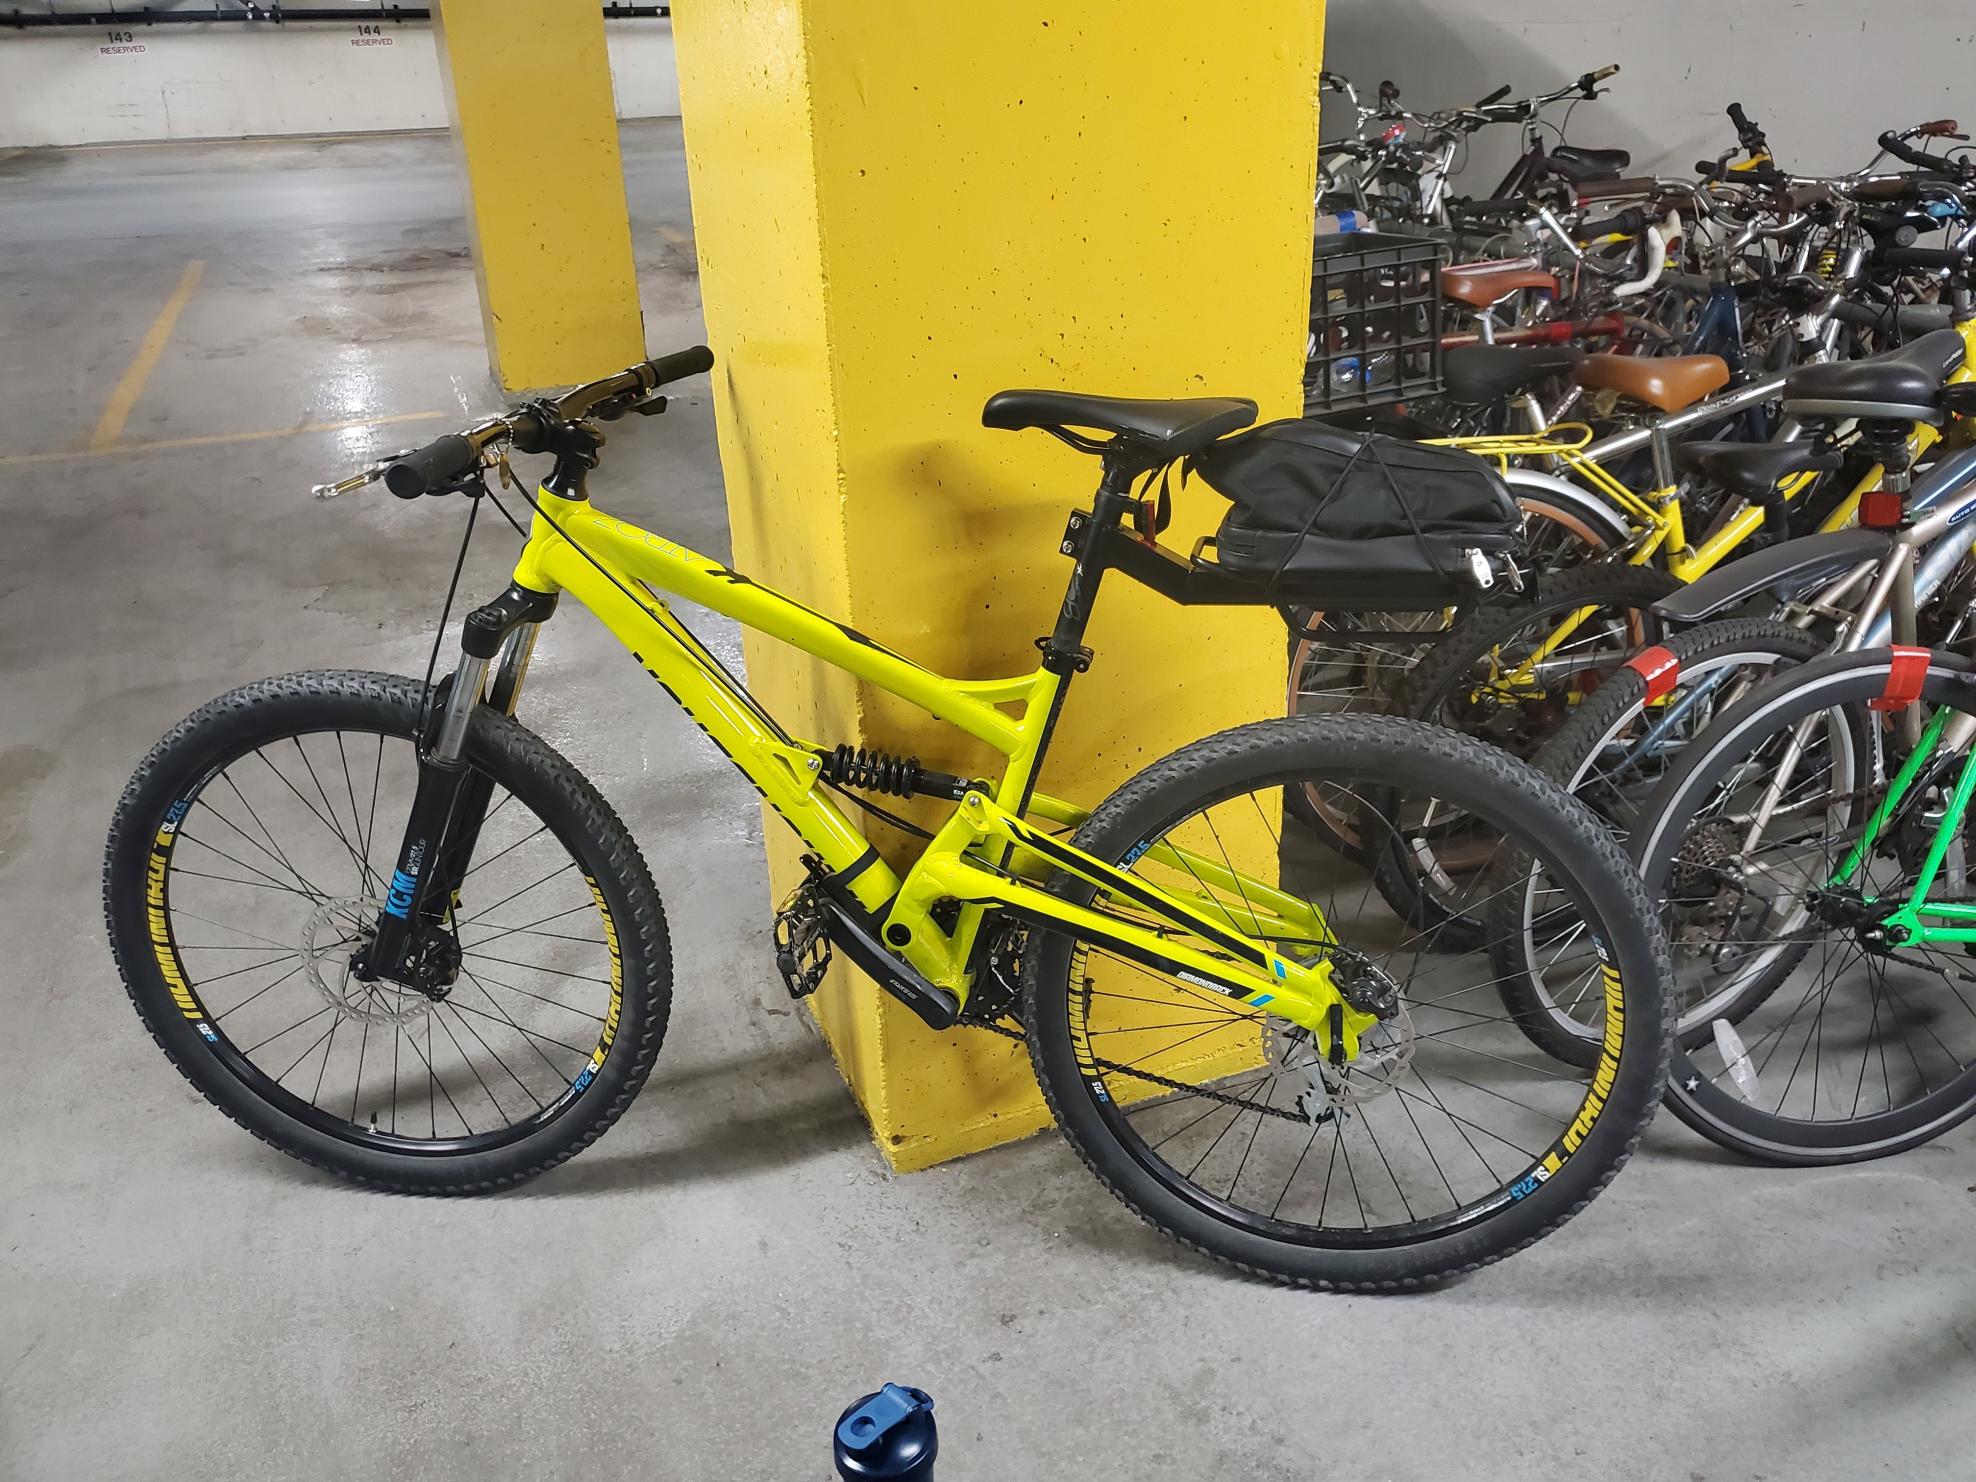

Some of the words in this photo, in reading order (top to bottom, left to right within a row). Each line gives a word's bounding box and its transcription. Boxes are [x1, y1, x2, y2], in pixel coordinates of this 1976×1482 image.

[357, 25, 382, 37] 144
[106, 32, 134, 44] 143
[350, 38, 394, 48] RESERVED
[99, 45, 147, 56] RESERVED
[1175, 969, 1234, 997] DIAMONDBACK
